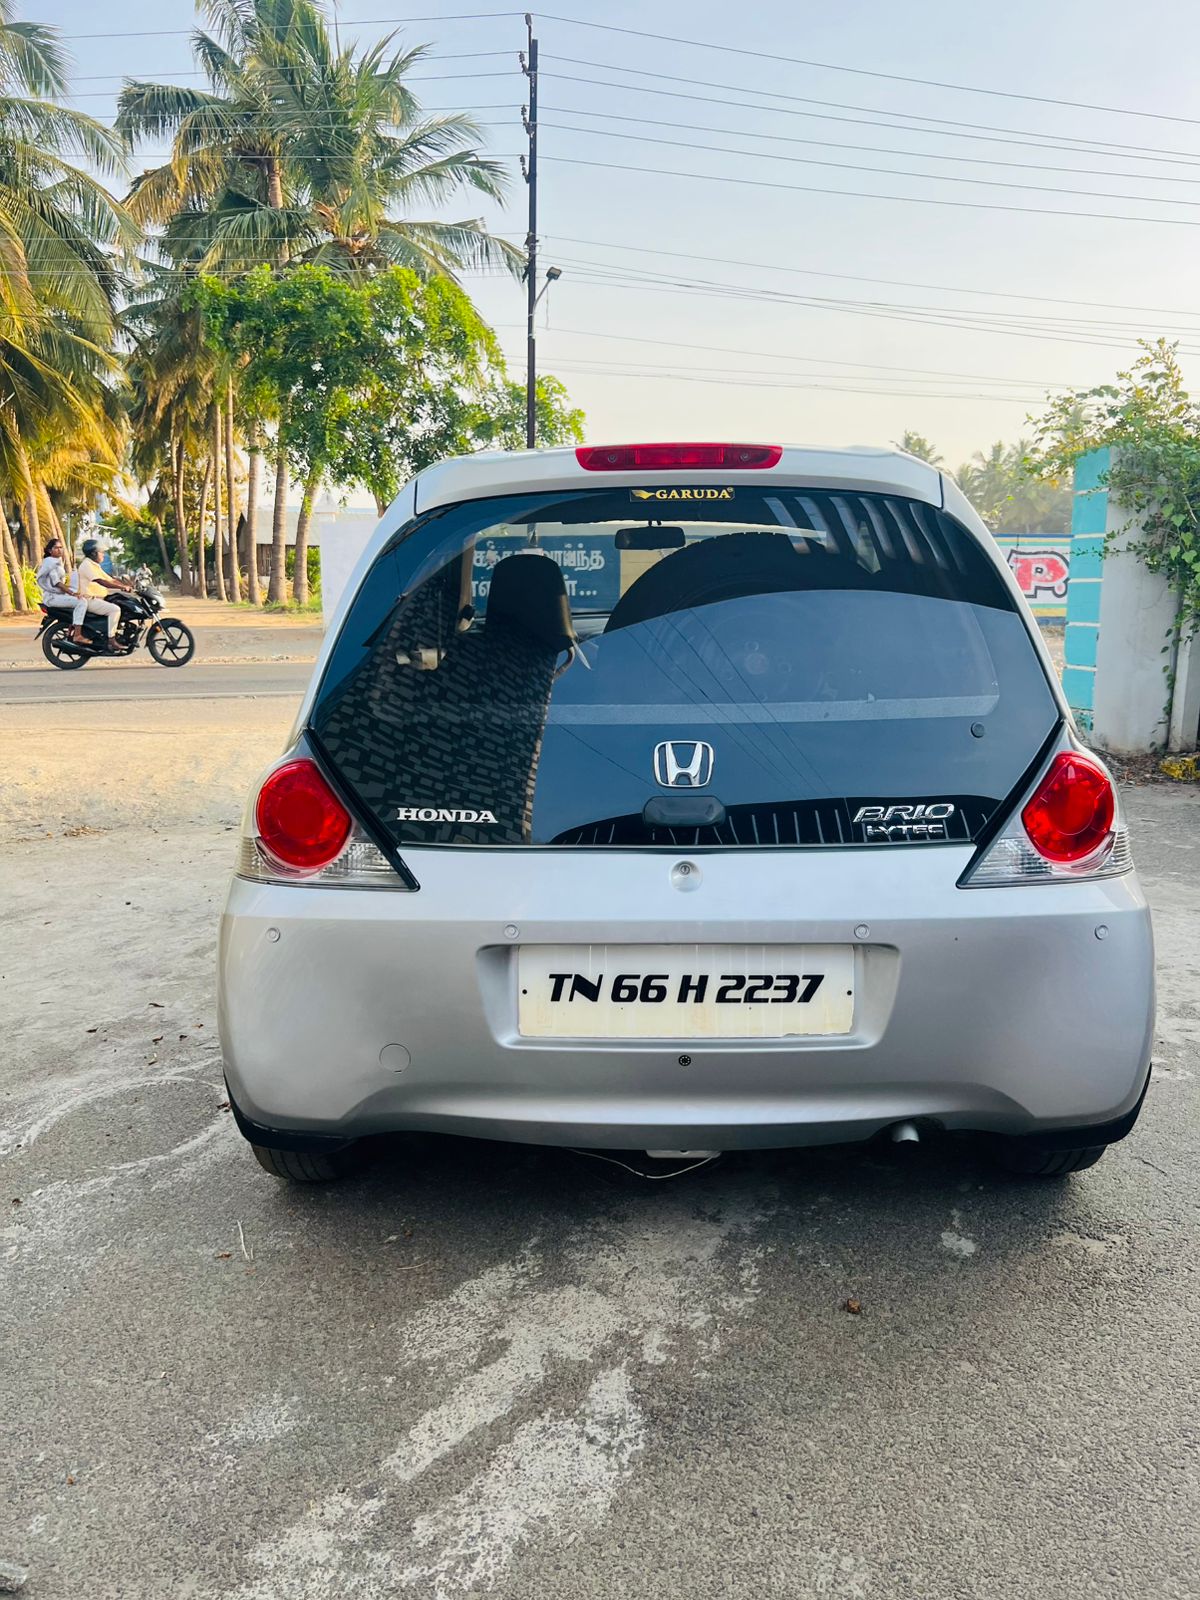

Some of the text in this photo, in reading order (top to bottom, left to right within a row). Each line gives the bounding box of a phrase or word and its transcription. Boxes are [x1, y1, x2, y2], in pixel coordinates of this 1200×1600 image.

[655, 488, 731, 500] GARUDA
[397, 807, 499, 824] HONDA
[853, 803, 955, 823] BRIO
[549, 974, 825, 1004] TN 66 H 2237
